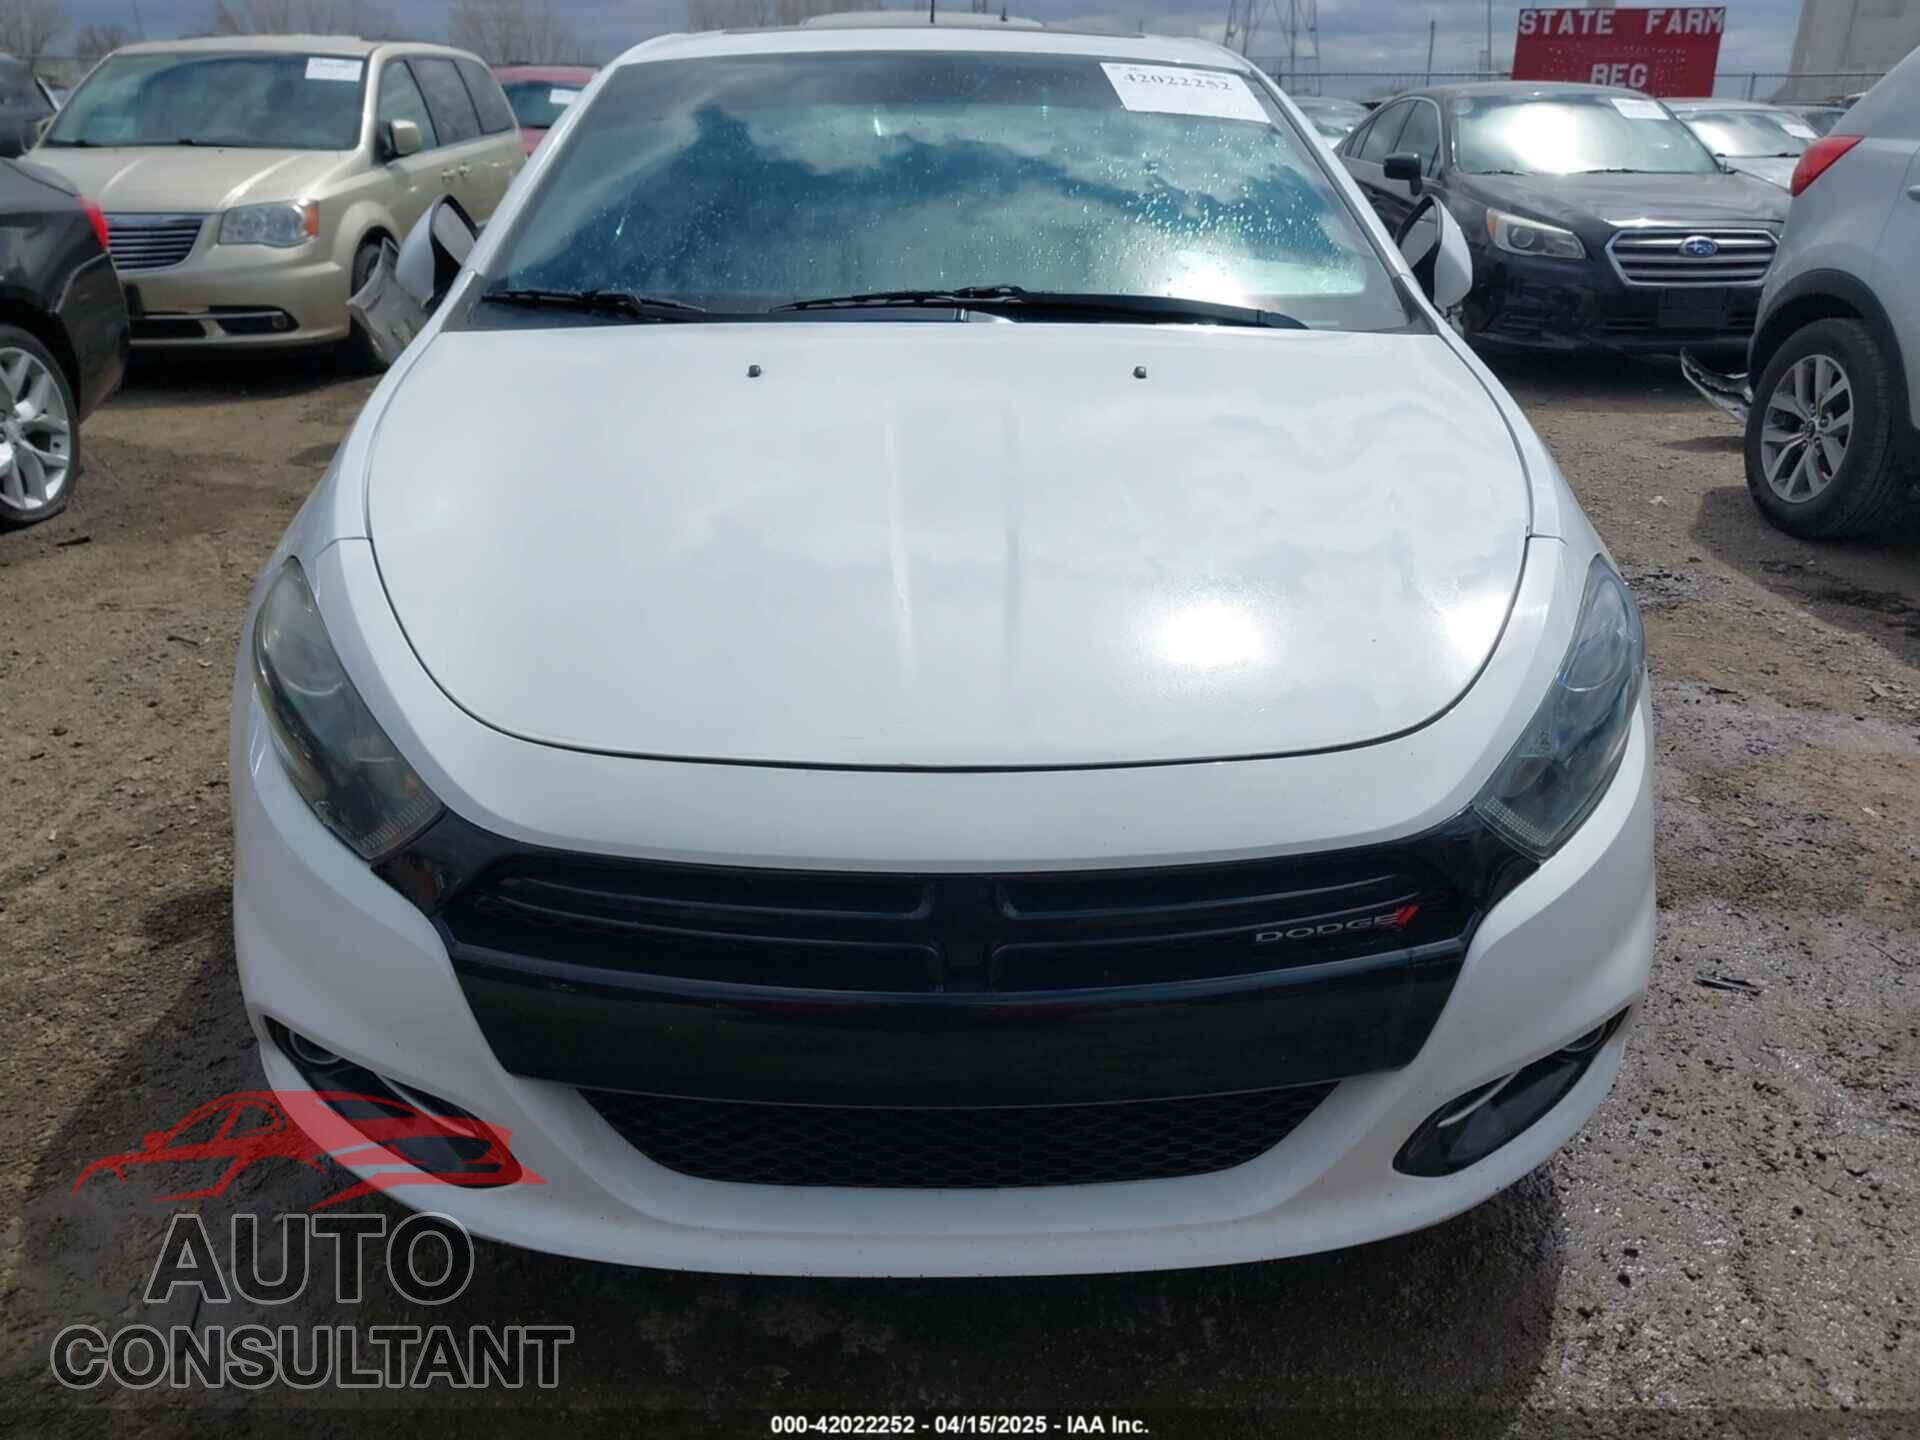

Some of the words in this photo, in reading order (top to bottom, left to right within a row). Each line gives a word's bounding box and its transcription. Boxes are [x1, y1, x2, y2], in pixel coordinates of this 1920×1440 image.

[1519, 9, 1615, 36] STATE
[1645, 8, 1725, 35] FARM
[1122, 72, 1232, 91] 42022252
[1591, 63, 1648, 88] REG
[1256, 912, 1399, 942] DODGE
